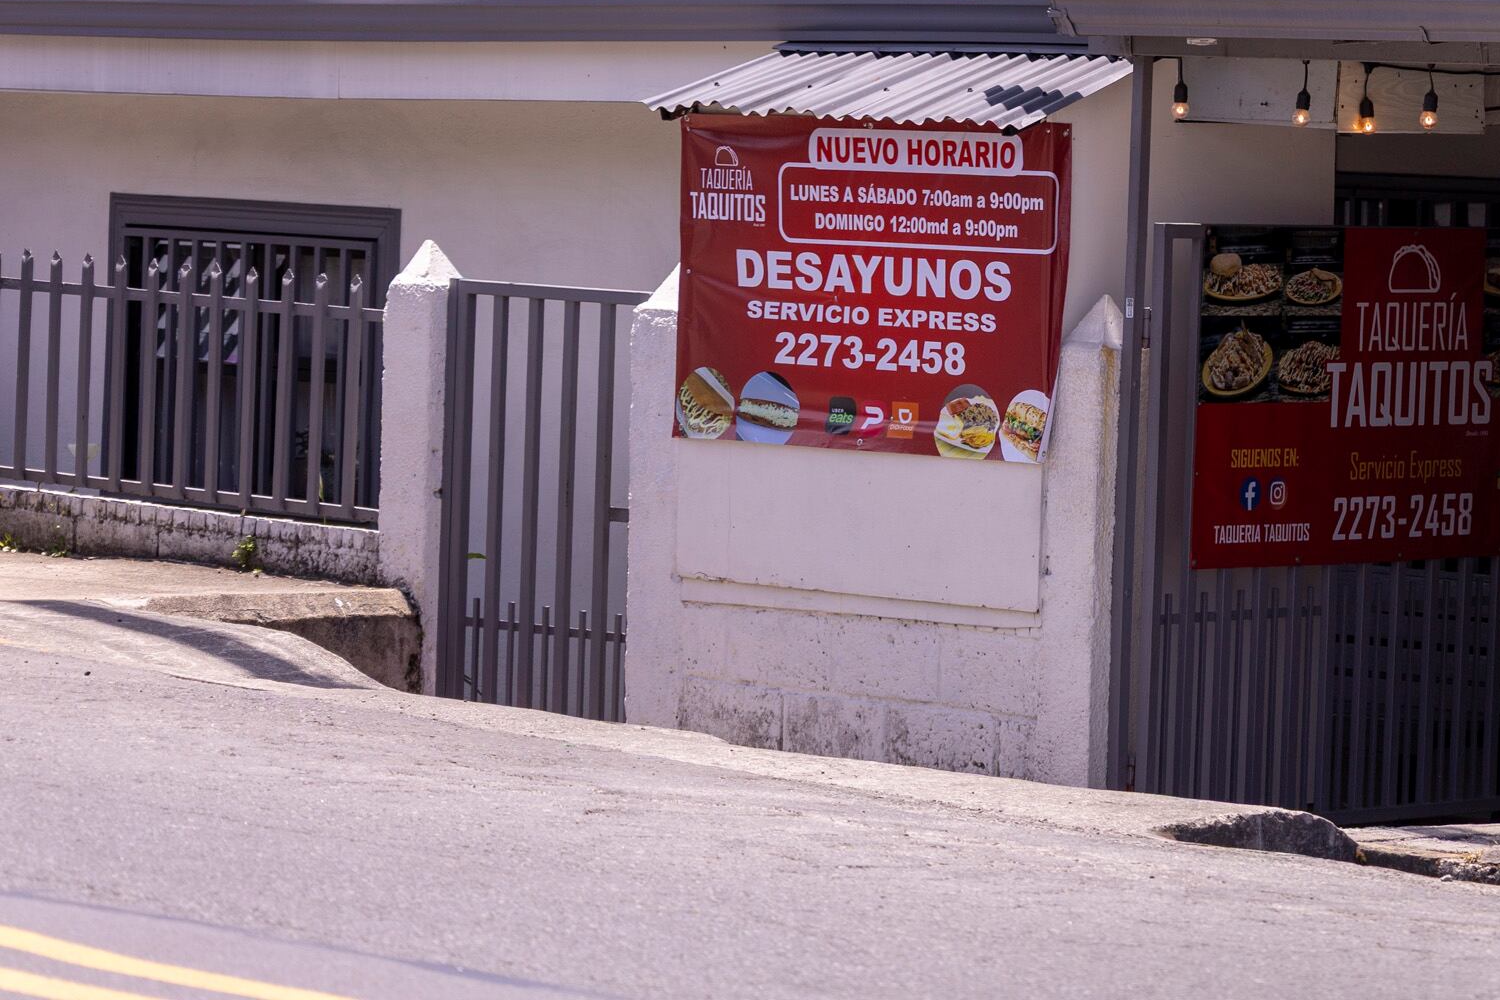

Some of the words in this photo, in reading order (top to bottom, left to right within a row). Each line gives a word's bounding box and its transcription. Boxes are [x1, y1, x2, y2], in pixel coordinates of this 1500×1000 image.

[816, 136, 899, 165] NUEVO
[907, 139, 1017, 169] HORARIO
[700, 166, 753, 190] TAQUERÍA
[690, 191, 766, 222] TAQUITOS
[790, 183, 840, 203] LUNES
[843, 186, 854, 203] A
[857, 184, 917, 206] SÁBADO
[922, 189, 973, 208] 7:00am
[977, 195, 986, 208] a
[989, 192, 1044, 214] 9:00pm
[815, 212, 885, 233] DOMINGO
[890, 215, 949, 236] 12:00md
[952, 221, 961, 236] a
[965, 218, 1019, 241] 9:00pm
[736, 248, 1012, 302] DESAYUNOS
[746, 300, 870, 326] SERVICIO
[877, 307, 997, 333] EXPRESS
[1356, 292, 1469, 352] TAQUERÍA
[774, 331, 966, 376] 2273-2458
[1326, 360, 1493, 429] TAQUITOS
[829, 411, 854, 424] eats
[1231, 448, 1281, 468] SIGUENOS
[1283, 448, 1299, 467] EN:
[1350, 452, 1405, 480] Servicio
[1409, 450, 1462, 483] Express
[1332, 492, 1473, 541] 2273-2458
[1214, 524, 1261, 544] TAQUERIA
[1264, 523, 1310, 541] TAQUITOS
